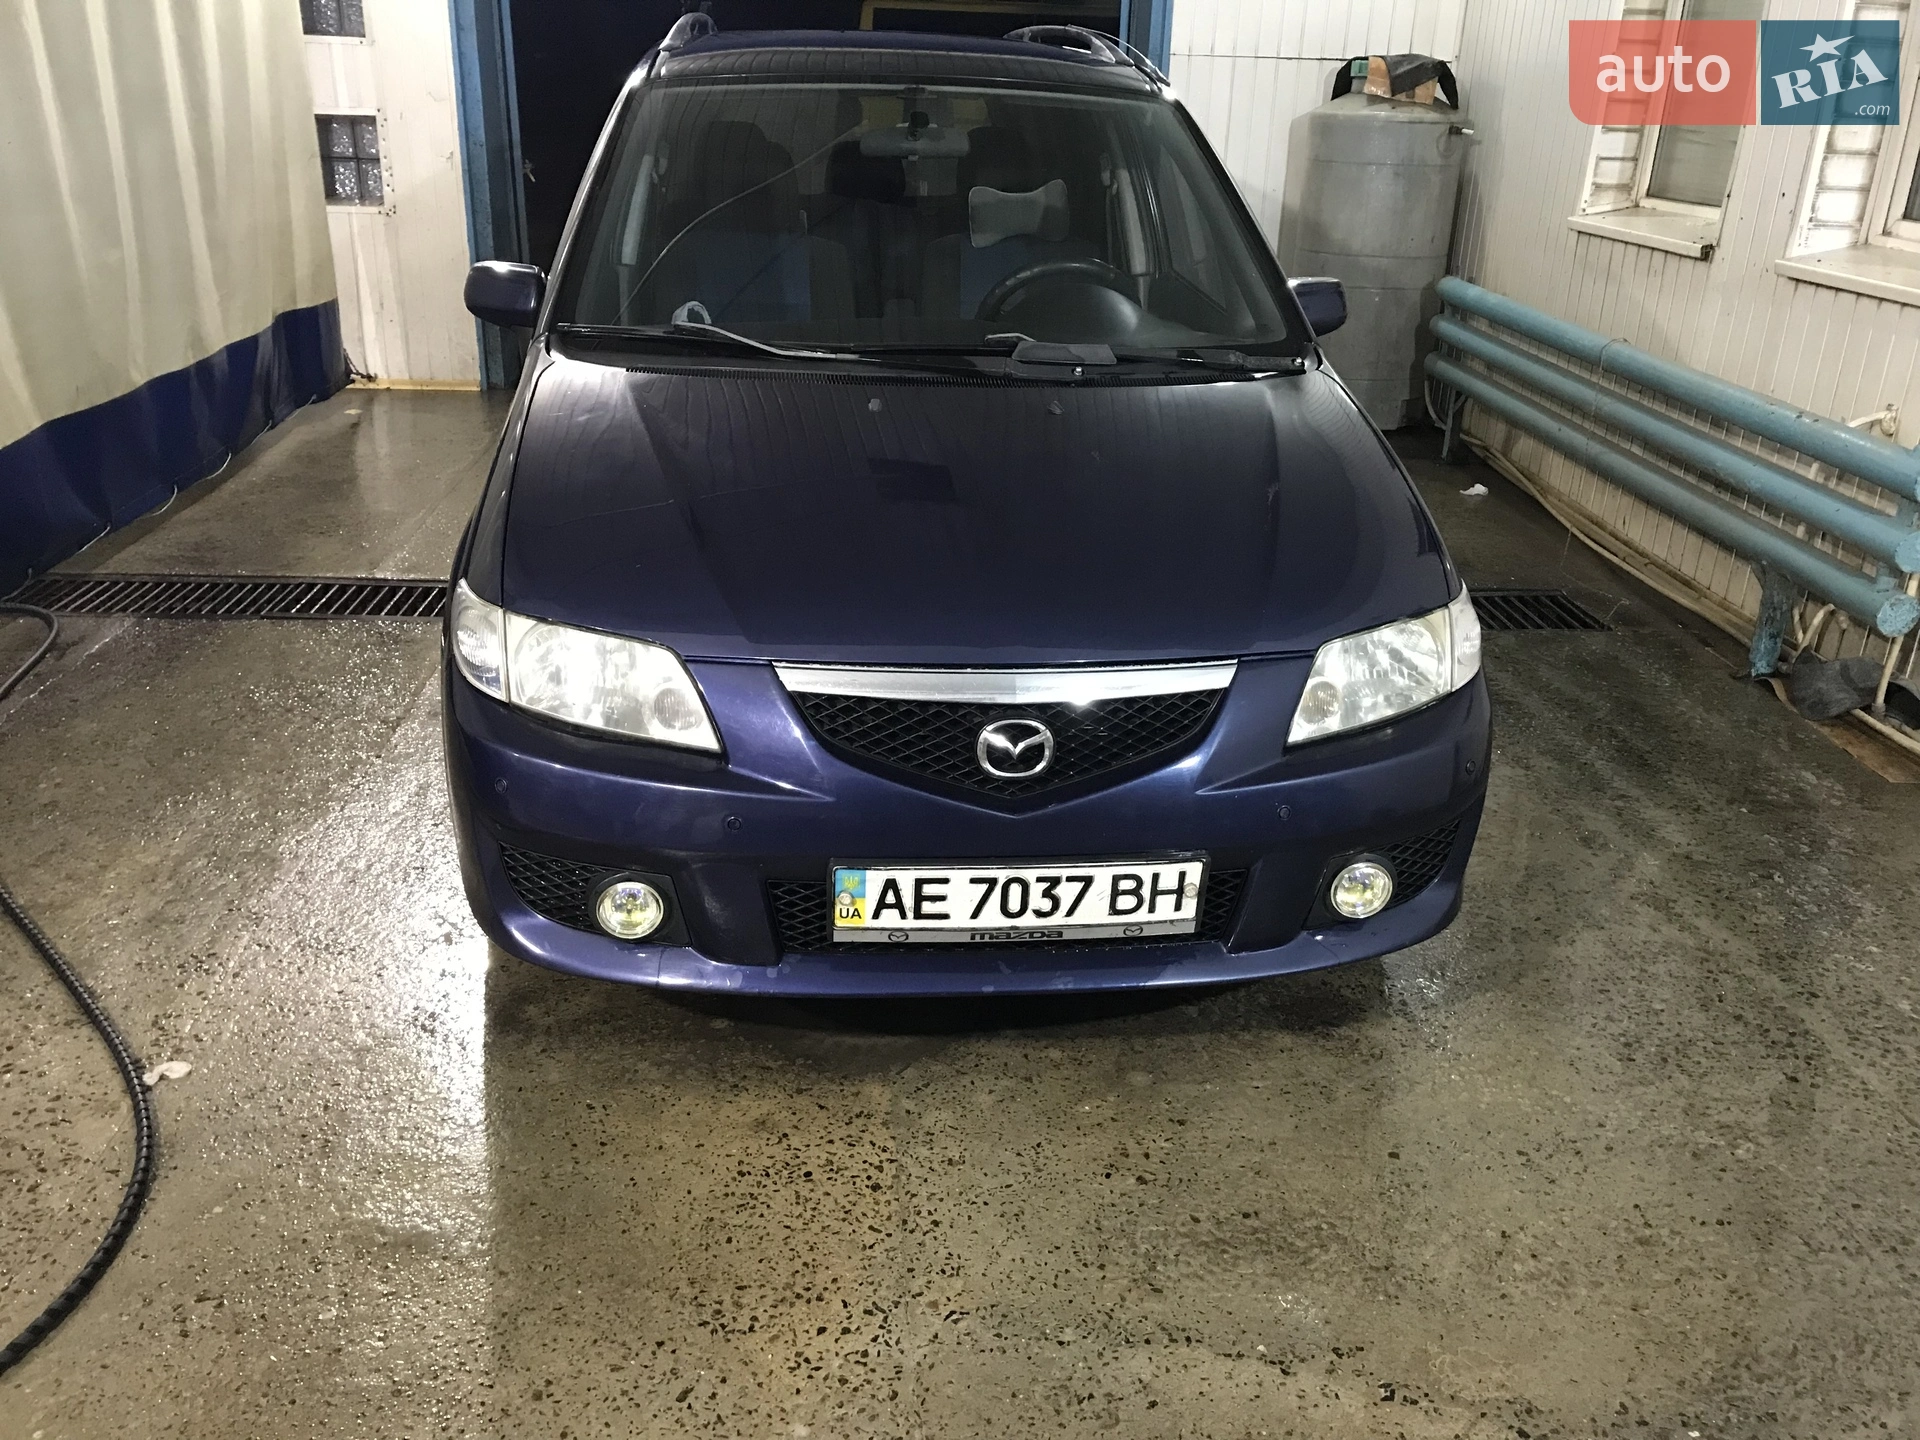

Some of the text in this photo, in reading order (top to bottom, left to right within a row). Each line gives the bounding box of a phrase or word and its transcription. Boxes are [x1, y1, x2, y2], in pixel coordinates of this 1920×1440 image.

[871, 870, 1187, 921] AE 7037 BH
[839, 907, 862, 920] UA
[969, 929, 1064, 941] mazda
